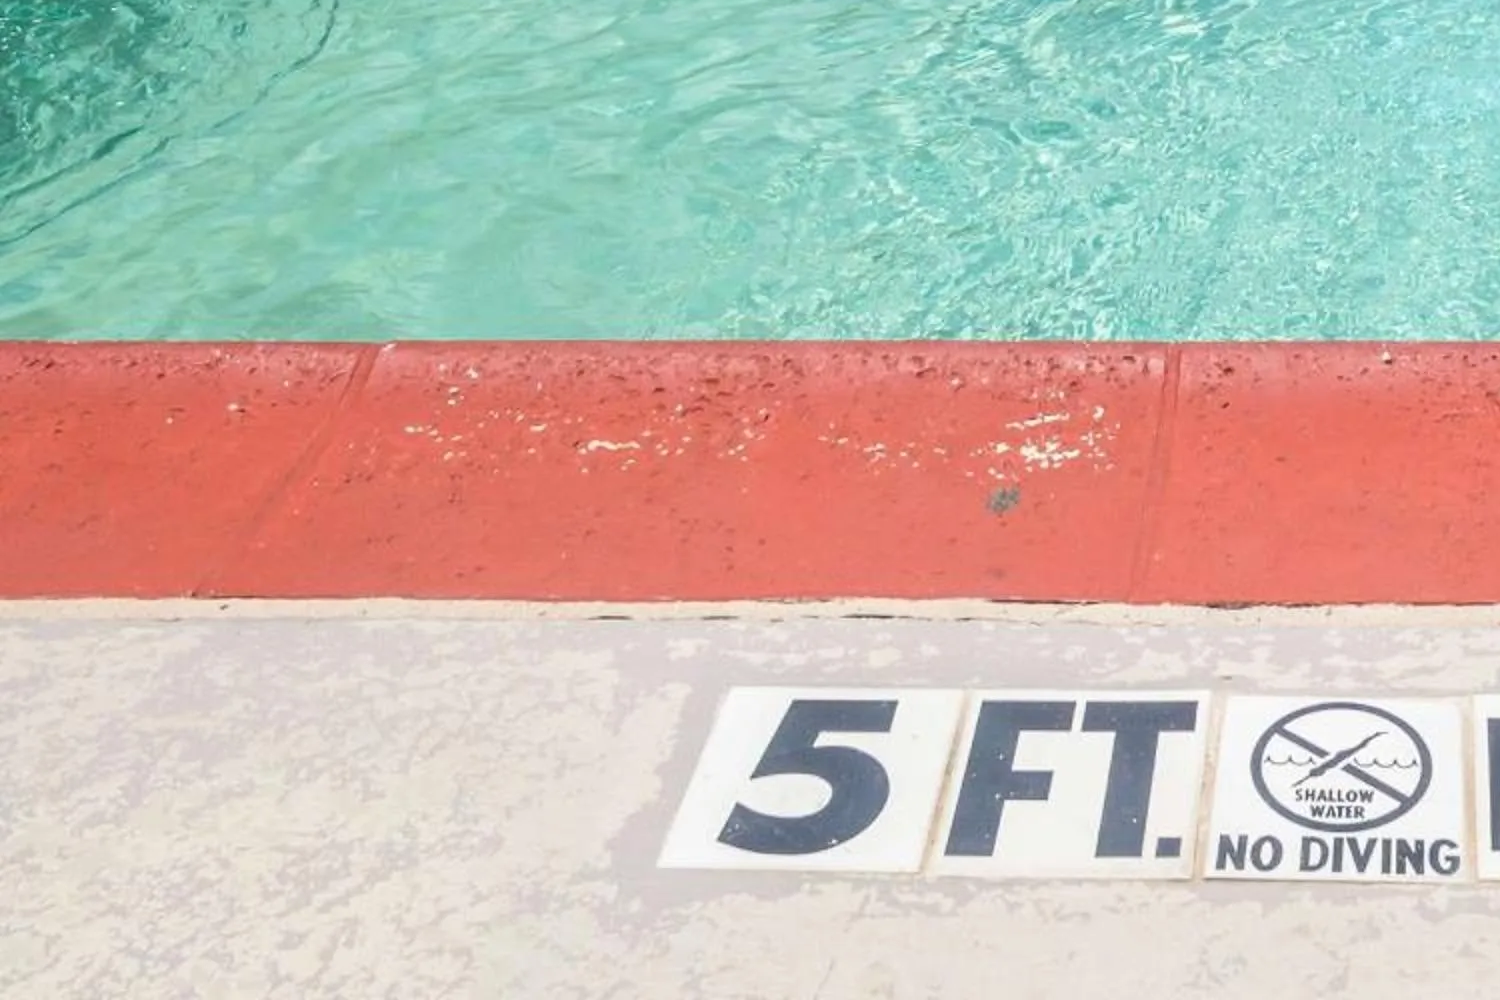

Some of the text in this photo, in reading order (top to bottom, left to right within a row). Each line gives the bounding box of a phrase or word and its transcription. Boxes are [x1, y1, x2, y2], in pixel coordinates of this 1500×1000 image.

[716, 698, 1199, 858] 5 FT.
[1294, 787, 1376, 804] SHALLOW
[1309, 804, 1366, 819] WATER
[1214, 833, 1461, 876] NO DIVING
